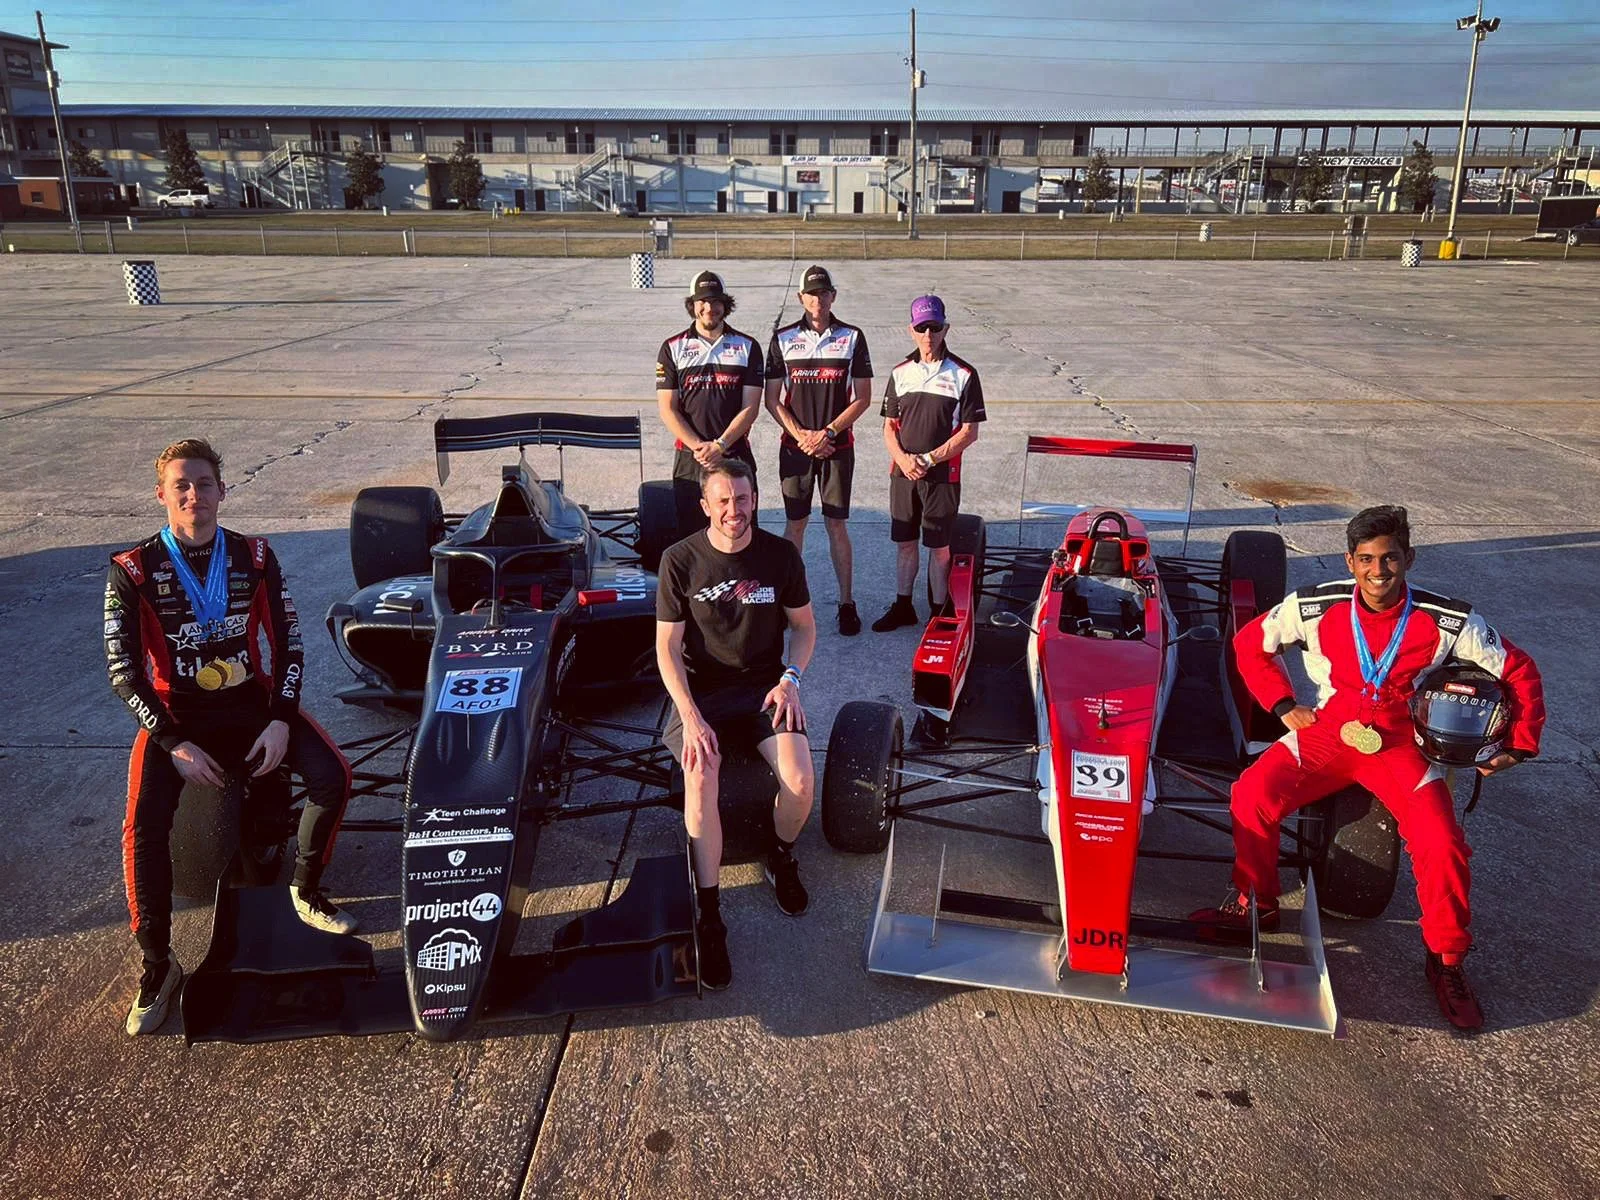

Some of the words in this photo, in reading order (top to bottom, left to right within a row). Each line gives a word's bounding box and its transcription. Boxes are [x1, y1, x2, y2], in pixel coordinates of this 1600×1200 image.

[1348, 157, 1394, 165] TERRACE
[793, 369, 820, 377] ARRIVE
[822, 369, 844, 377] DRIVE
[1301, 605, 1321, 615] OMP
[1439, 617, 1460, 627] OMP
[447, 641, 534, 653] BYRD
[922, 655, 944, 664] JM
[282, 663, 300, 698] BYRD
[449, 676, 510, 697] 88
[451, 698, 501, 710] AF01
[127, 693, 158, 729] BYRD
[1076, 765, 1125, 788] 39
[441, 809, 461, 817] Teen
[463, 808, 506, 816] Challenge
[408, 869, 467, 881] TIMOTHY
[471, 866, 503, 876] PLAN
[1074, 928, 1123, 949] JDR
[448, 941, 482, 971] FMX
[436, 983, 466, 994] Kipsu
